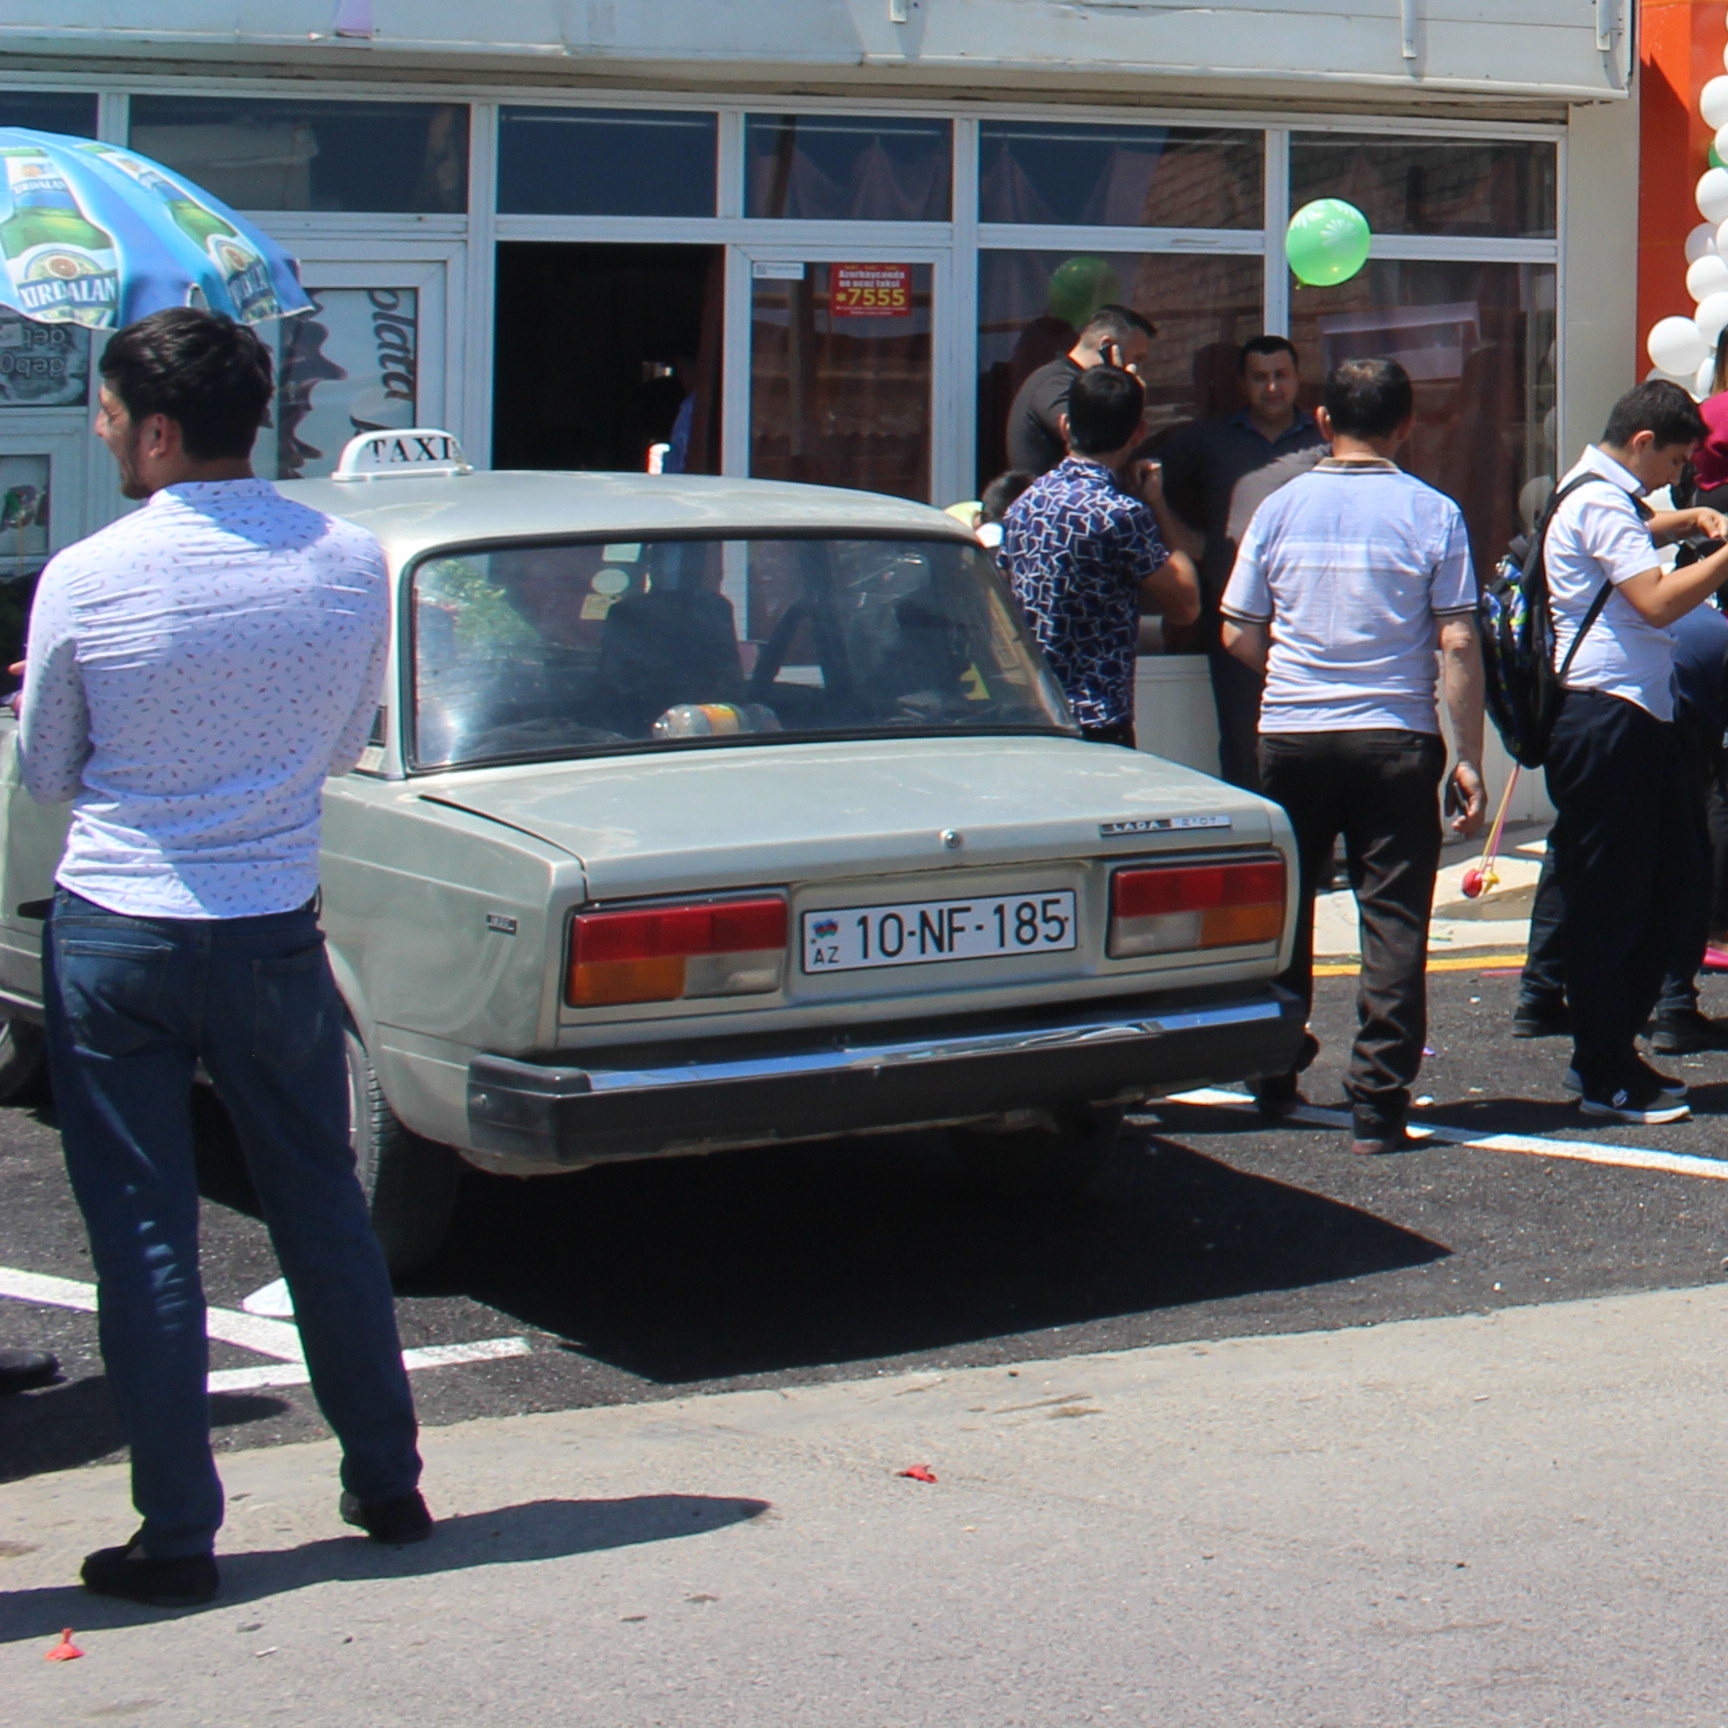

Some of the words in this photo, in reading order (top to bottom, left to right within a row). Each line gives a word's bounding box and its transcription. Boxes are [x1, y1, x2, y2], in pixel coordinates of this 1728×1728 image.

[367, 437, 451, 464] TAXI
[1113, 821, 1160, 832] LADA
[855, 897, 1066, 959] 10-NF-185
[813, 946, 839, 964] AZ
